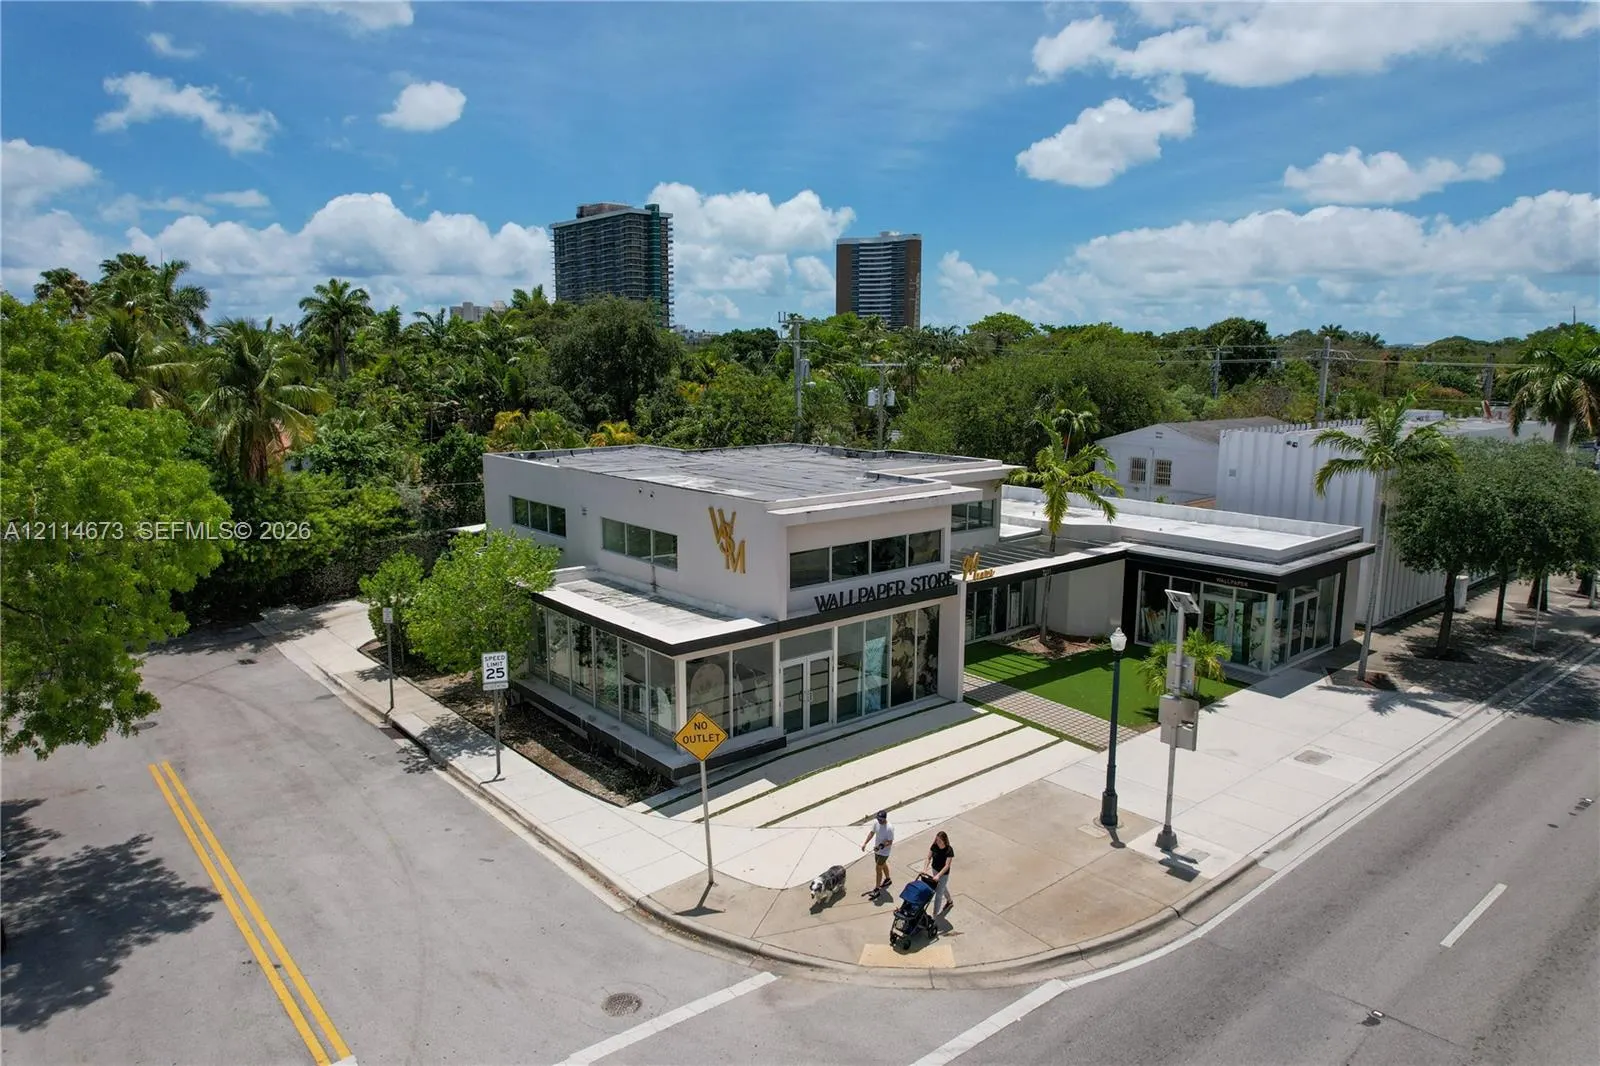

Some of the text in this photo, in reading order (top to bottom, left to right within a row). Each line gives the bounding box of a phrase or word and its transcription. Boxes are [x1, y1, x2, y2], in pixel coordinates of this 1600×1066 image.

[814, 571, 956, 612] WALLPAPER STORE
[485, 667, 505, 680] 25
[694, 721, 708, 730] NO
[682, 733, 720, 744] OUTLET
